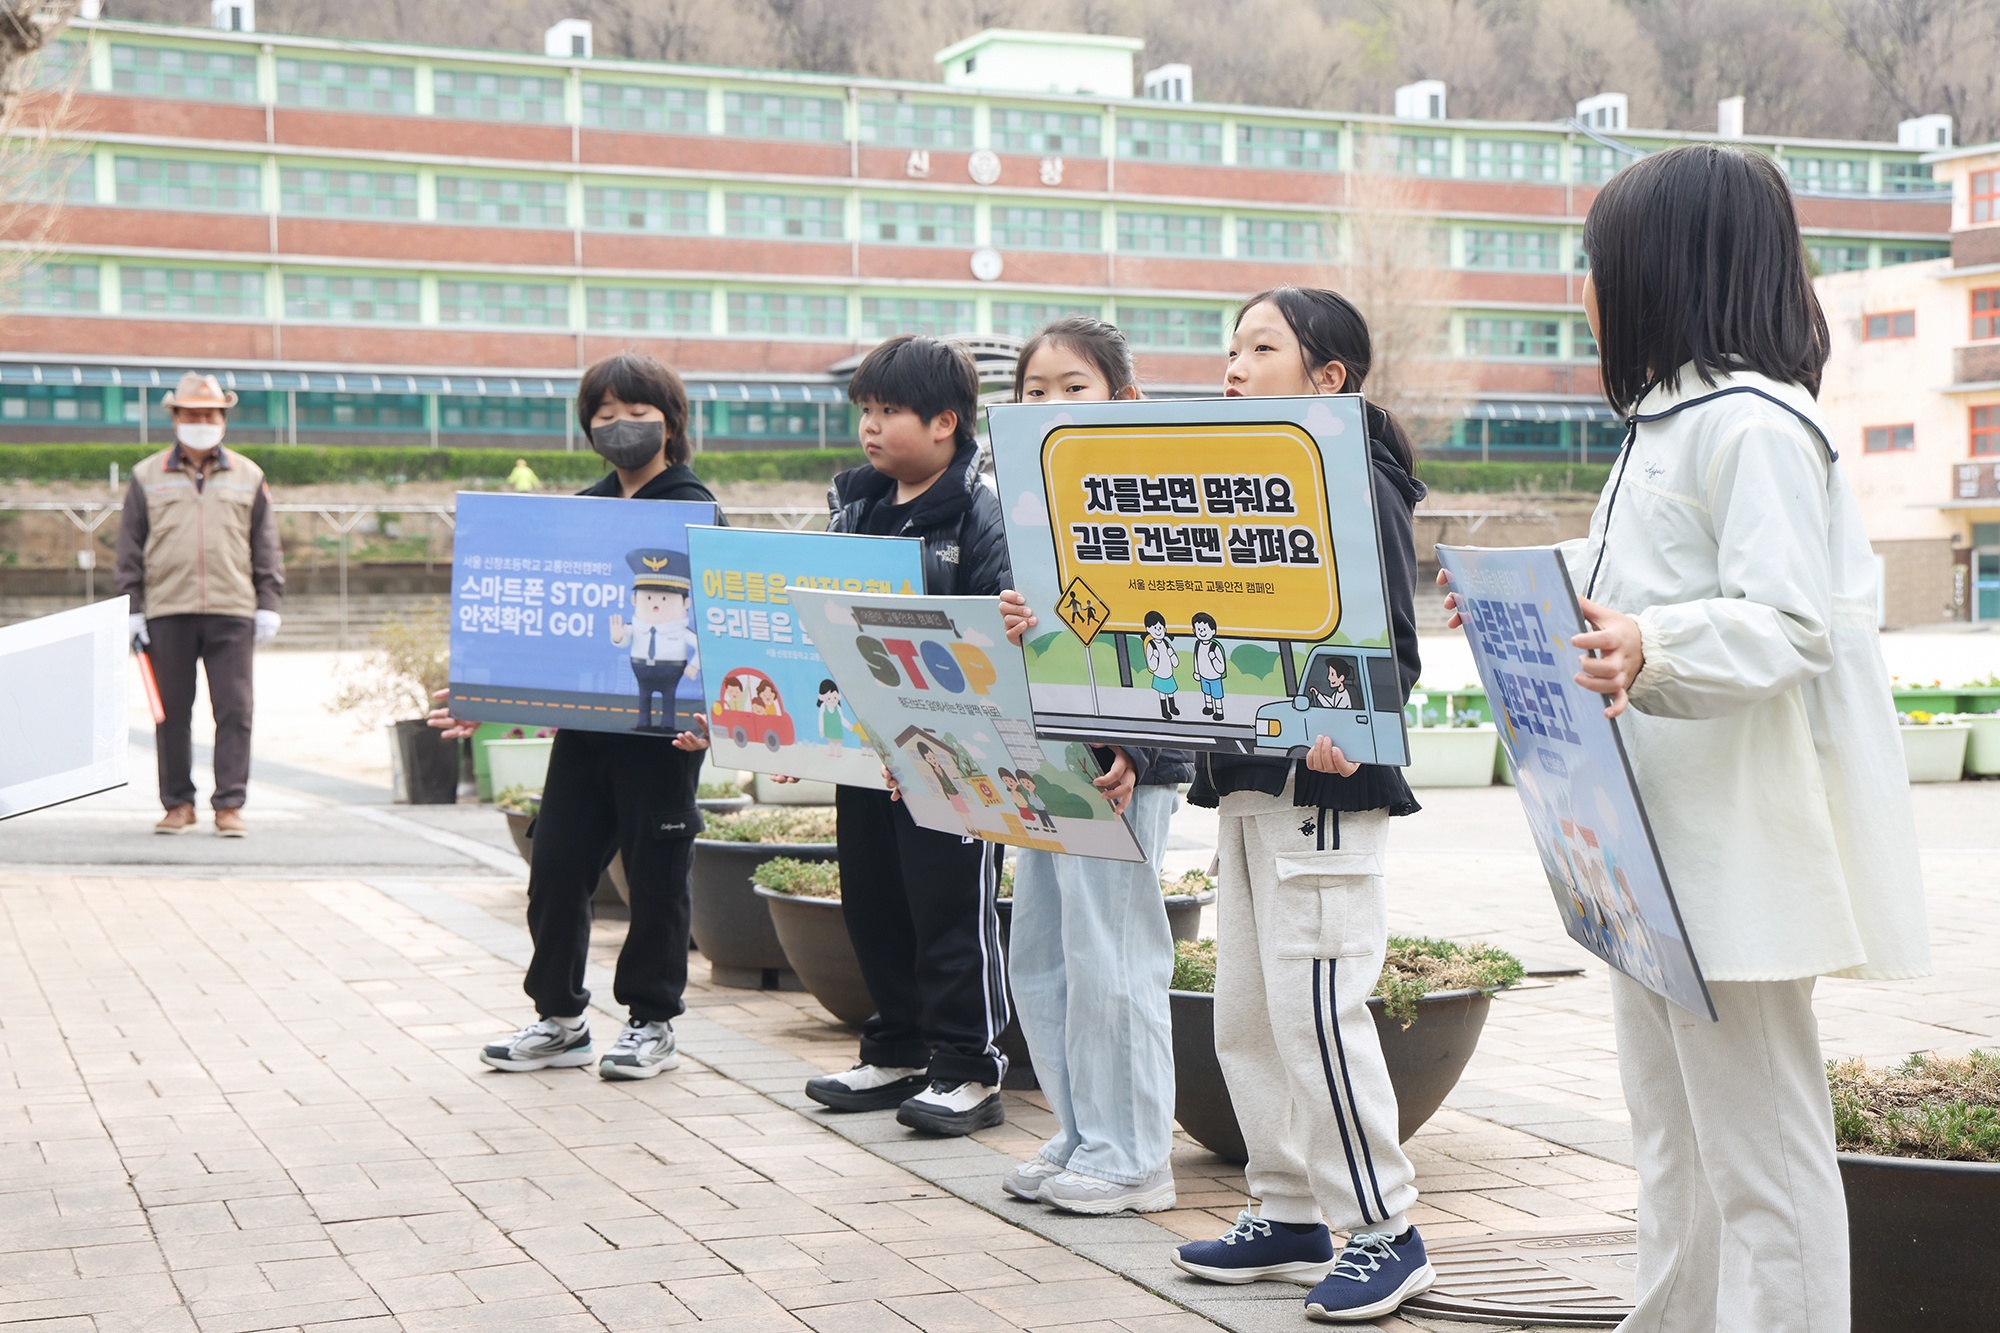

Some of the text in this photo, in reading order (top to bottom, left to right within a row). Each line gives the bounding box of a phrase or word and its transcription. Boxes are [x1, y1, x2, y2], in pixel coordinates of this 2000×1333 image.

[1083, 478, 1294, 513] 차를보면 멈춰요
[936, 550, 959, 559] NORTH
[1073, 526, 1319, 564] 길을 건널땐 살펴요
[463, 556, 481, 569] 서울
[484, 557, 541, 572] 신창초등학교
[459, 575, 625, 609] 스마트폰 STOP!
[703, 569, 789, 604] 어른들은
[1128, 579, 1275, 594] 서울 신창초등학교 교통안전 캠페인
[459, 604, 594, 638] 안전확인 GO!
[706, 607, 793, 643] 우리들은
[1468, 598, 1556, 666] 오른쪽보고
[856, 634, 997, 696] STOP
[1493, 668, 1582, 746] 왼쪽도보고
